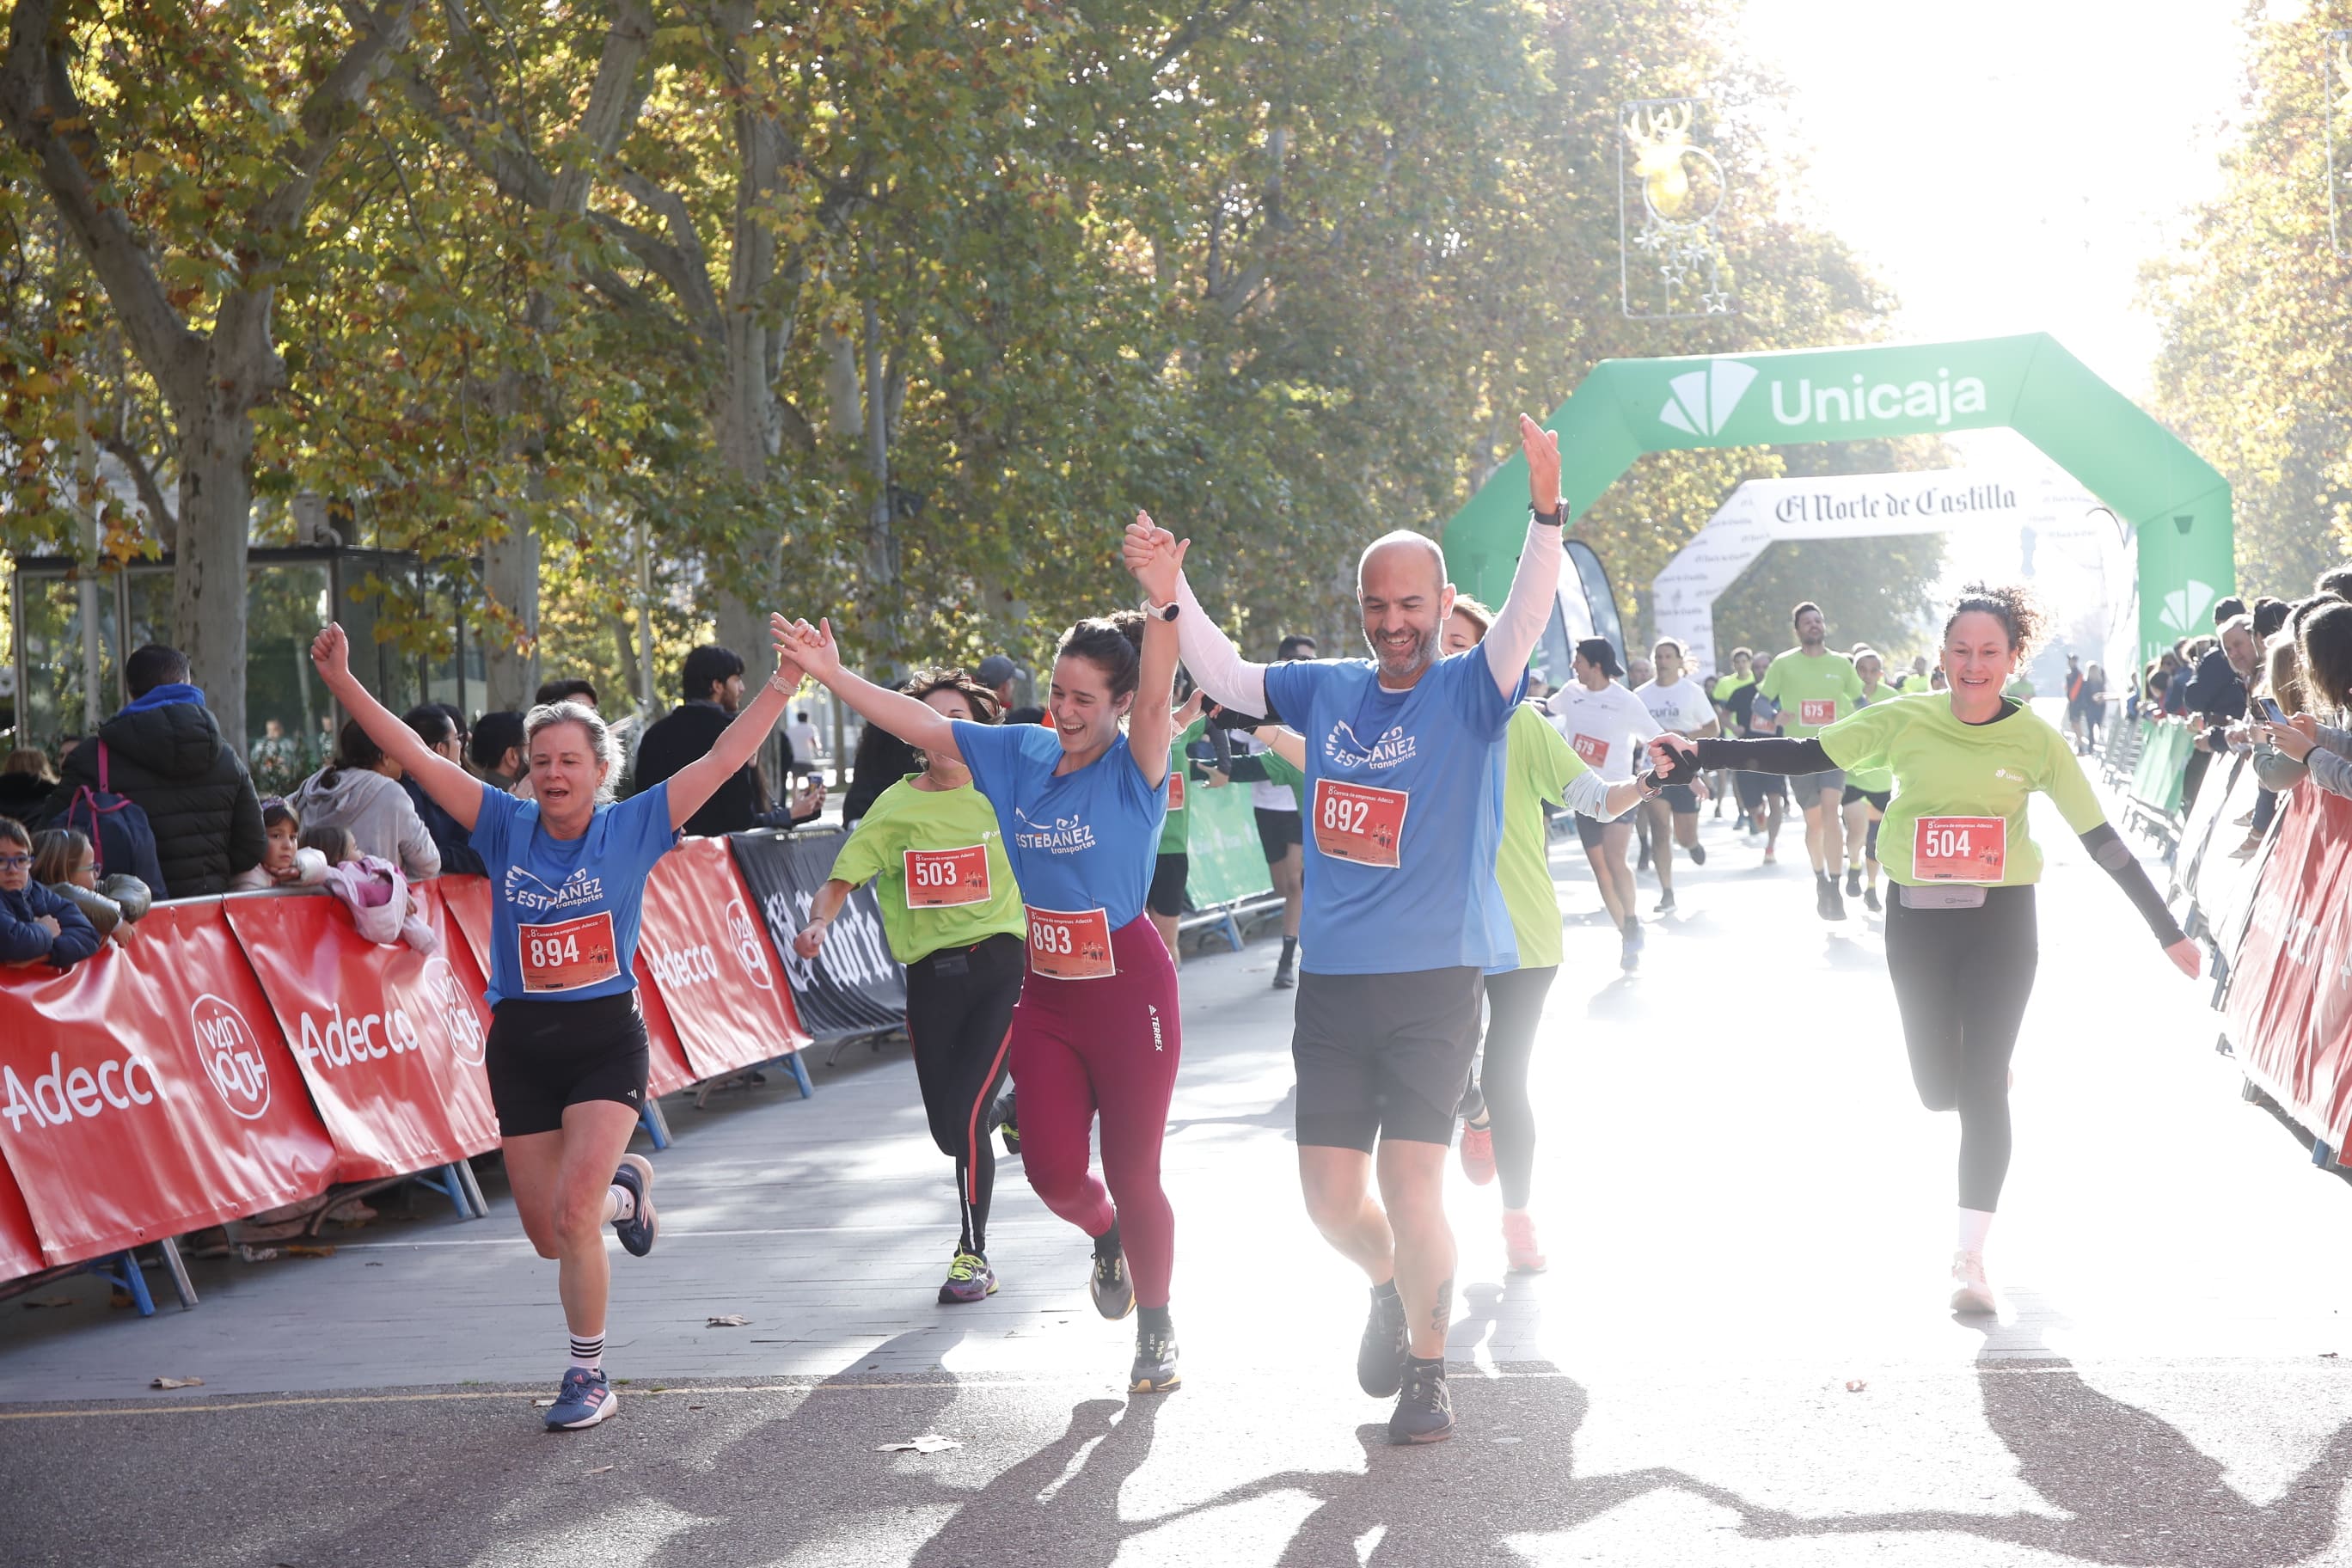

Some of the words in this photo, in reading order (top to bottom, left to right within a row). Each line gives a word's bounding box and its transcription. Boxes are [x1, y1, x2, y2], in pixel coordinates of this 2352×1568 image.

[1771, 367, 1987, 426] Unicaja
[1775, 495, 1808, 523] El
[1814, 493, 1880, 522] Norte
[1885, 493, 1910, 516] de
[1916, 484, 2017, 516] Castilla
[1804, 704, 1823, 717] 675
[1369, 750, 1417, 770] transportes
[1573, 739, 1596, 756] 679
[1324, 797, 1369, 834] 892
[1050, 839, 1096, 854] transportes
[1926, 830, 1970, 857] 504
[916, 861, 957, 885] 503
[555, 892, 603, 910] transportes
[530, 934, 579, 968] 894
[1032, 922, 1072, 954] 893
[652, 939, 719, 989] Adecco
[301, 1002, 419, 1069] Adecco
[1151, 1016, 1163, 1052] TERREX
